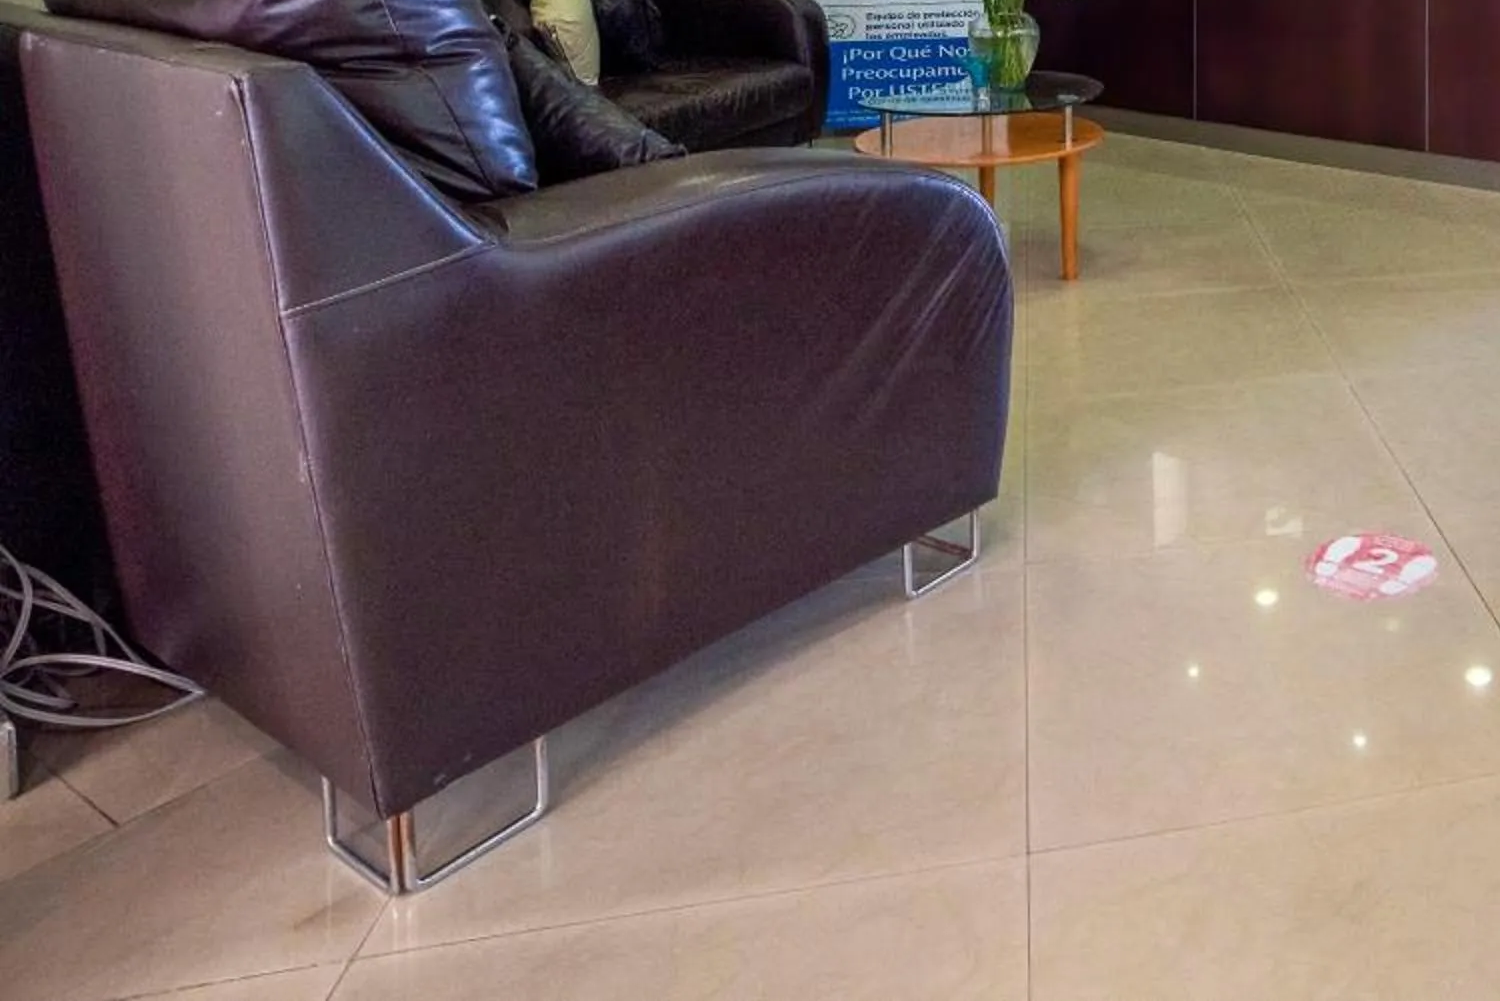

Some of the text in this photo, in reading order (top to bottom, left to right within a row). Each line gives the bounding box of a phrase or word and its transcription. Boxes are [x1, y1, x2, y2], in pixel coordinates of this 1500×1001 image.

[889, 44, 931, 62] Qué
[848, 85, 885, 100] Por
[1352, 547, 1399, 575] 2
